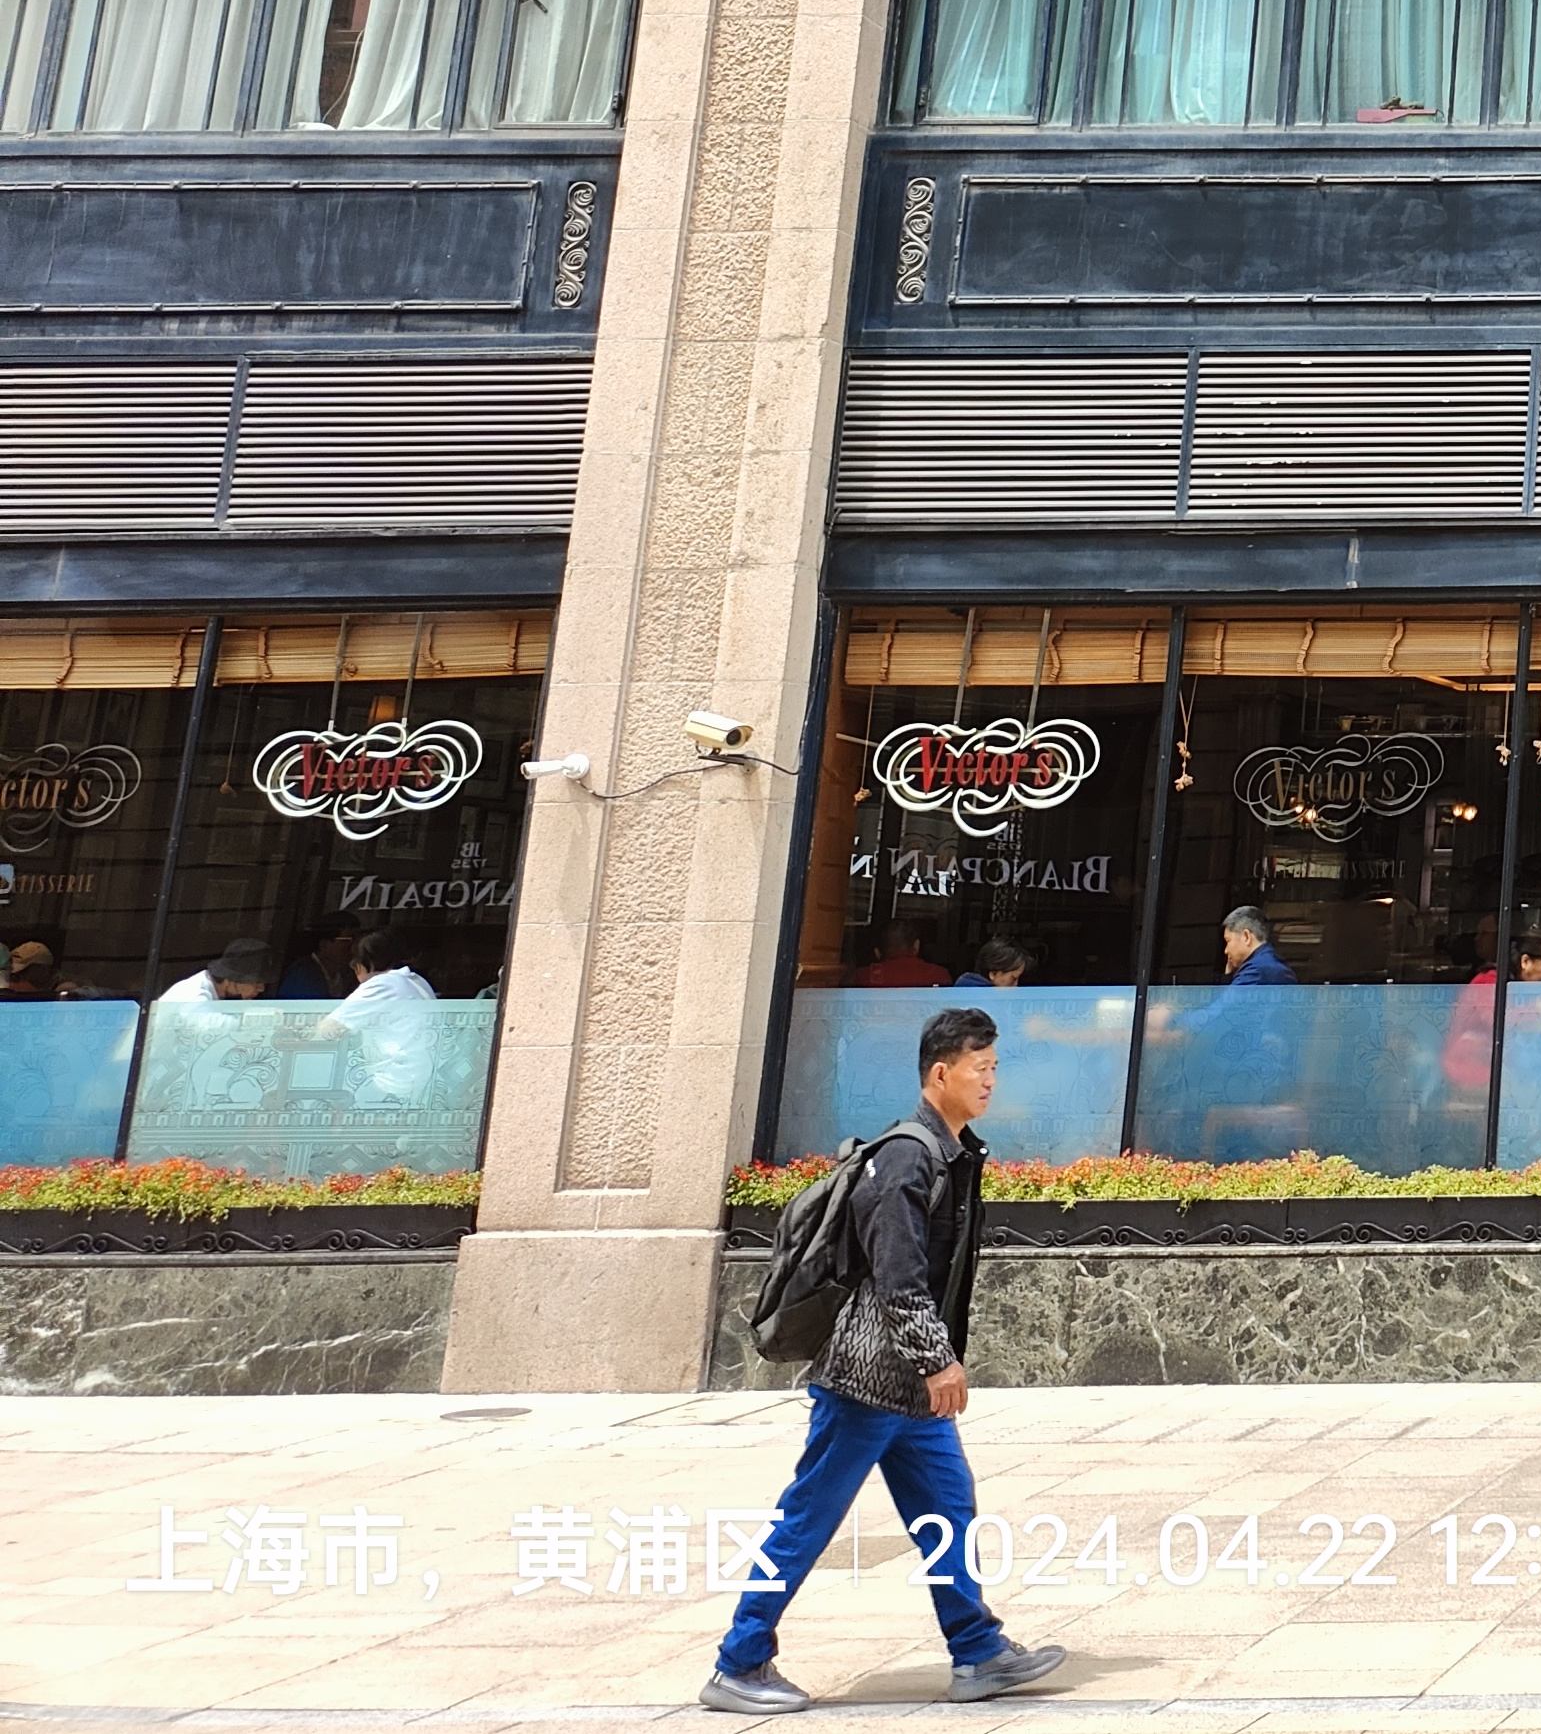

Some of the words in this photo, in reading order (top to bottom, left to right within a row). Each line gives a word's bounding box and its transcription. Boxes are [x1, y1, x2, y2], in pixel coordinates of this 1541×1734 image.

[300, 741, 435, 802] Victor's
[918, 736, 1053, 794] Victor's
[1273, 755, 1397, 811] Victor's
